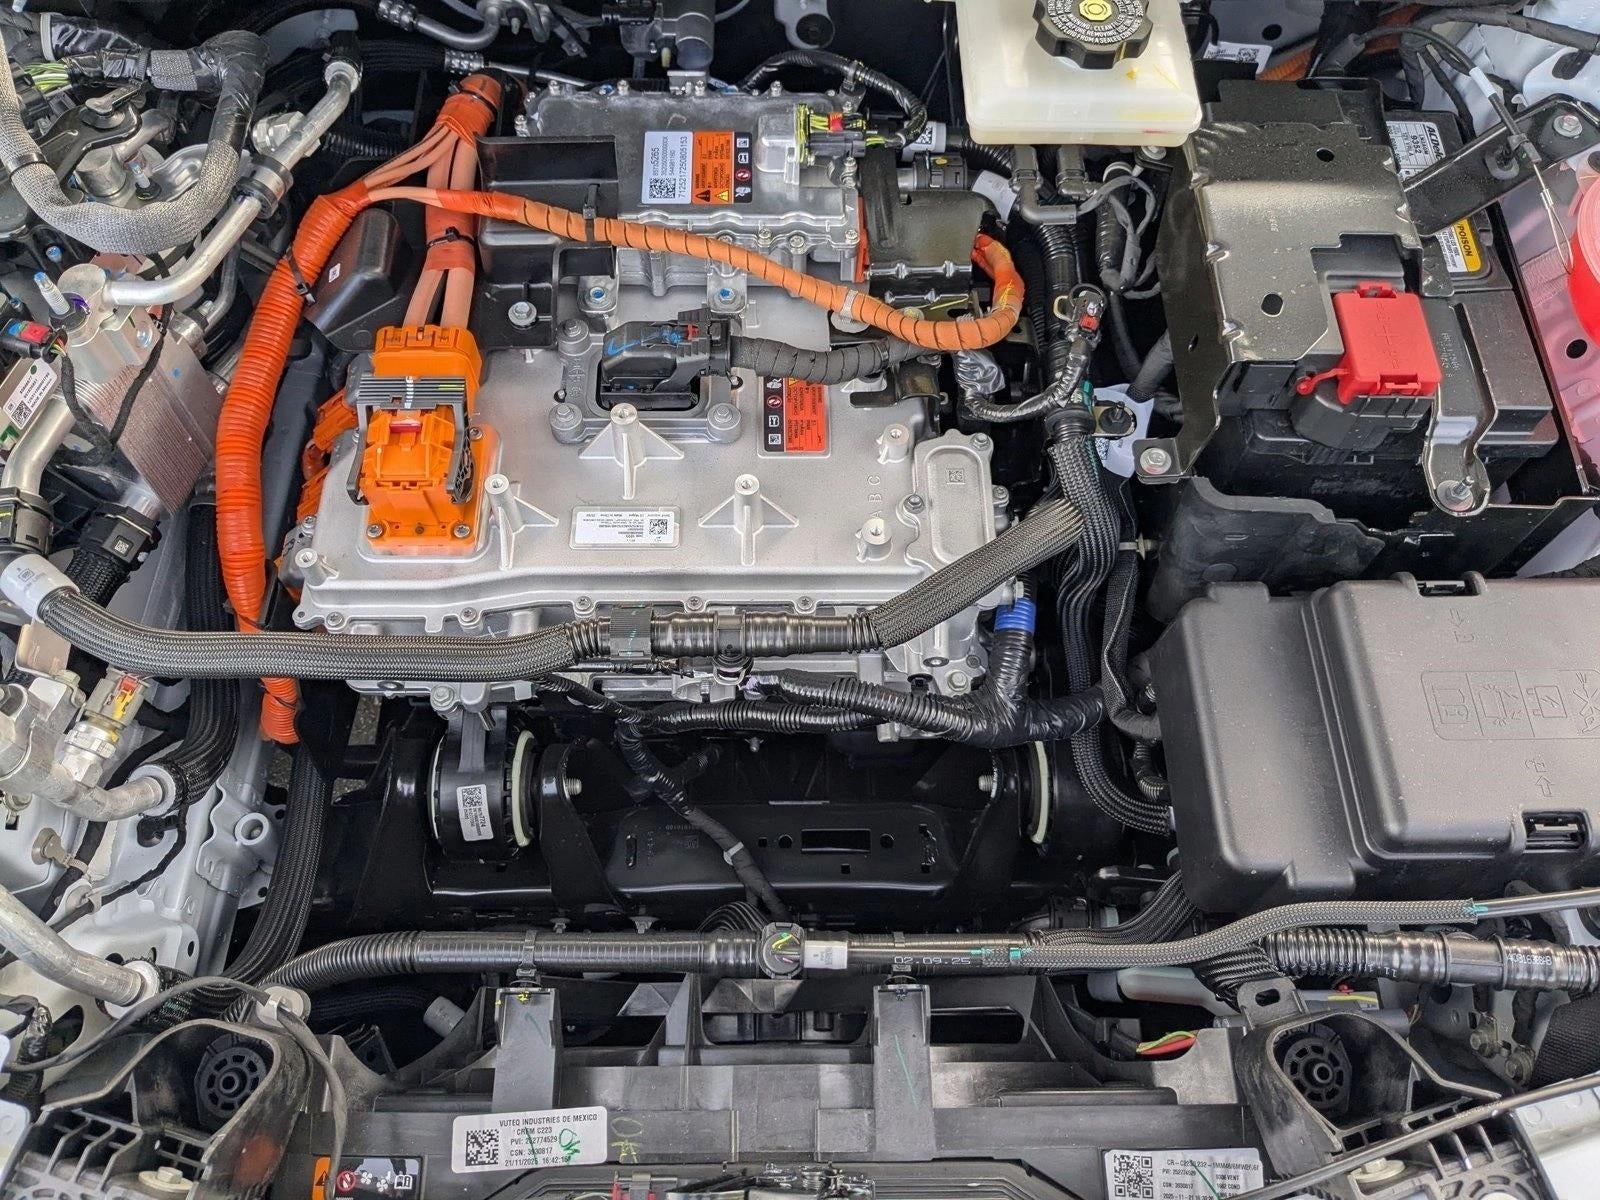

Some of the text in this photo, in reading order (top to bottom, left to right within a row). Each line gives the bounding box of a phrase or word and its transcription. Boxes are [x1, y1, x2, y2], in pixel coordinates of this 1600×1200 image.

[1067, 13, 1090, 30] WARNING
[1411, 135, 1421, 154] 9352
[1426, 126, 1444, 160] ACDelc
[894, 956, 971, 965] 02.09.25
[499, 1113, 598, 1127] VUTEQ INDUSTRIES DE MEXICO
